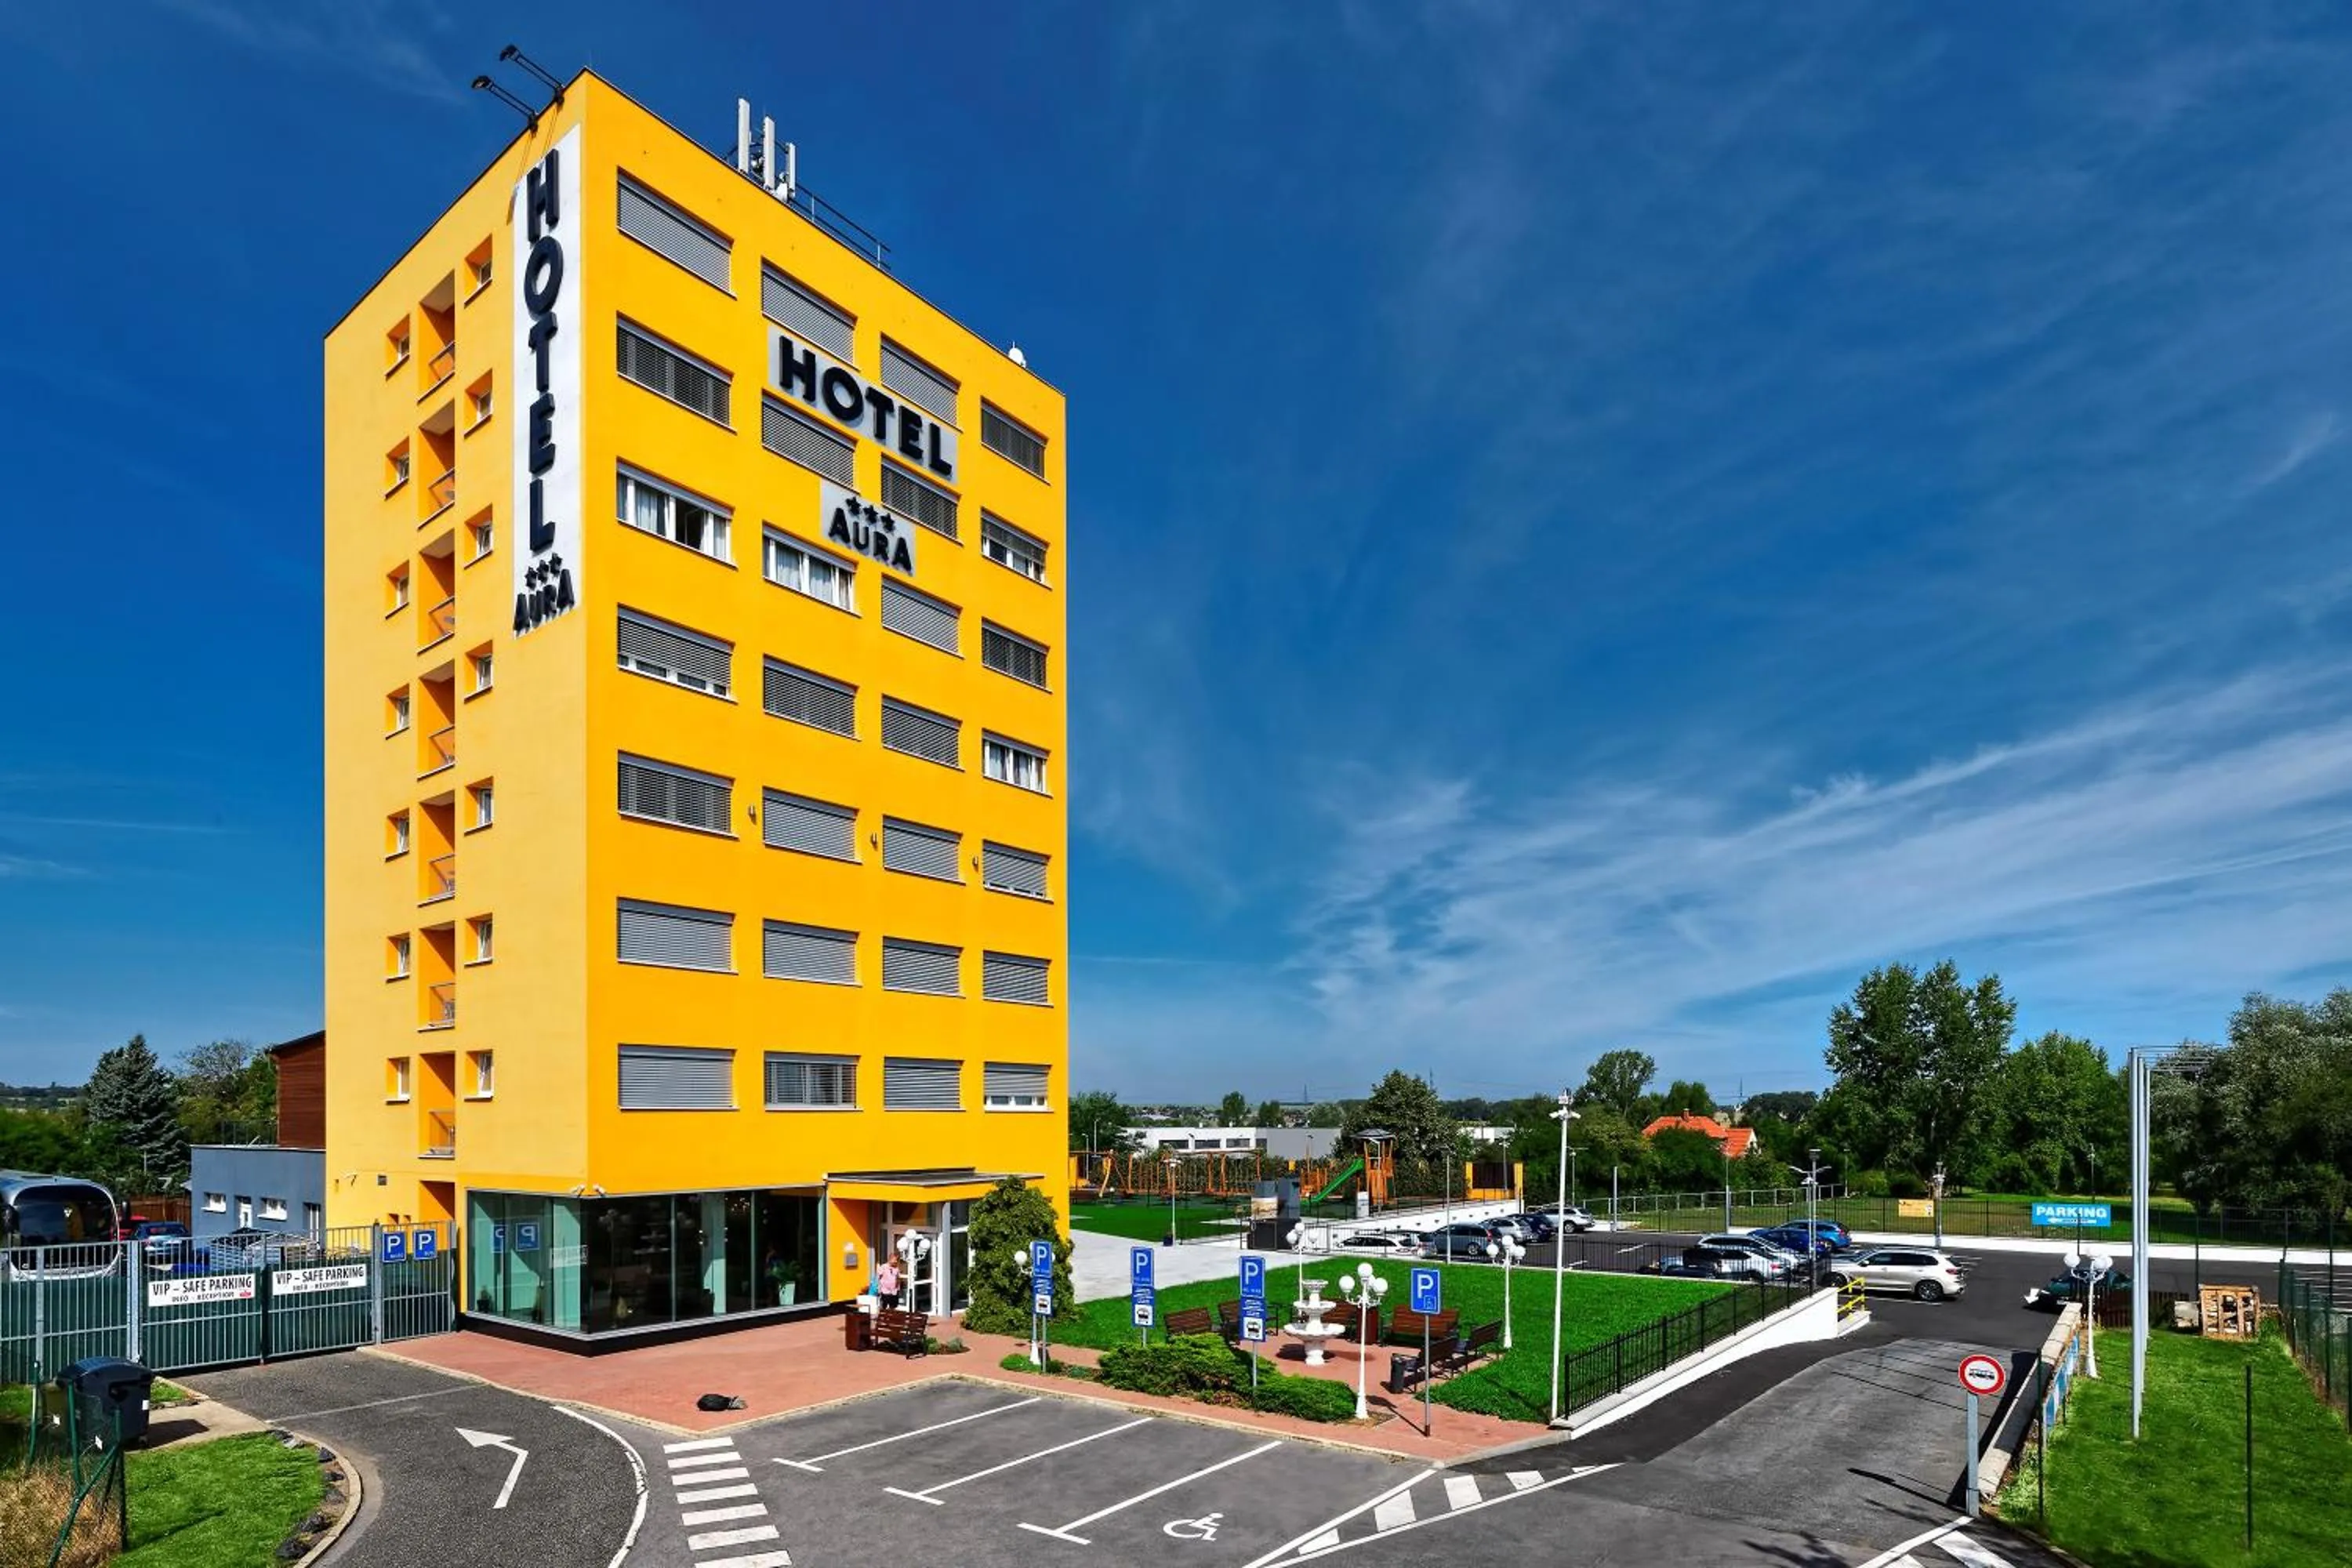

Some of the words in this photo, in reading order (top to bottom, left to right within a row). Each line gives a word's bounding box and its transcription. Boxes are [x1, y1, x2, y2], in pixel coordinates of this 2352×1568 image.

[524, 149, 563, 552] HOTEL
[779, 336, 952, 475] HOTEL
[829, 508, 912, 572] AURA
[514, 569, 574, 632] AURA
[2036, 1206, 2107, 1218] PARKING
[387, 1236, 401, 1253] P
[419, 1234, 432, 1250] P
[1036, 1246, 1047, 1265] P
[1136, 1252, 1148, 1273] P
[276, 1272, 292, 1285] VIP
[303, 1269, 324, 1282] SAFE
[325, 1266, 365, 1280] PARKING
[1245, 1261, 1258, 1284] P
[153, 1282, 170, 1296] VIP
[183, 1279, 205, 1293] SAFE
[209, 1276, 252, 1291] PARKING
[1417, 1274, 1434, 1298] P
